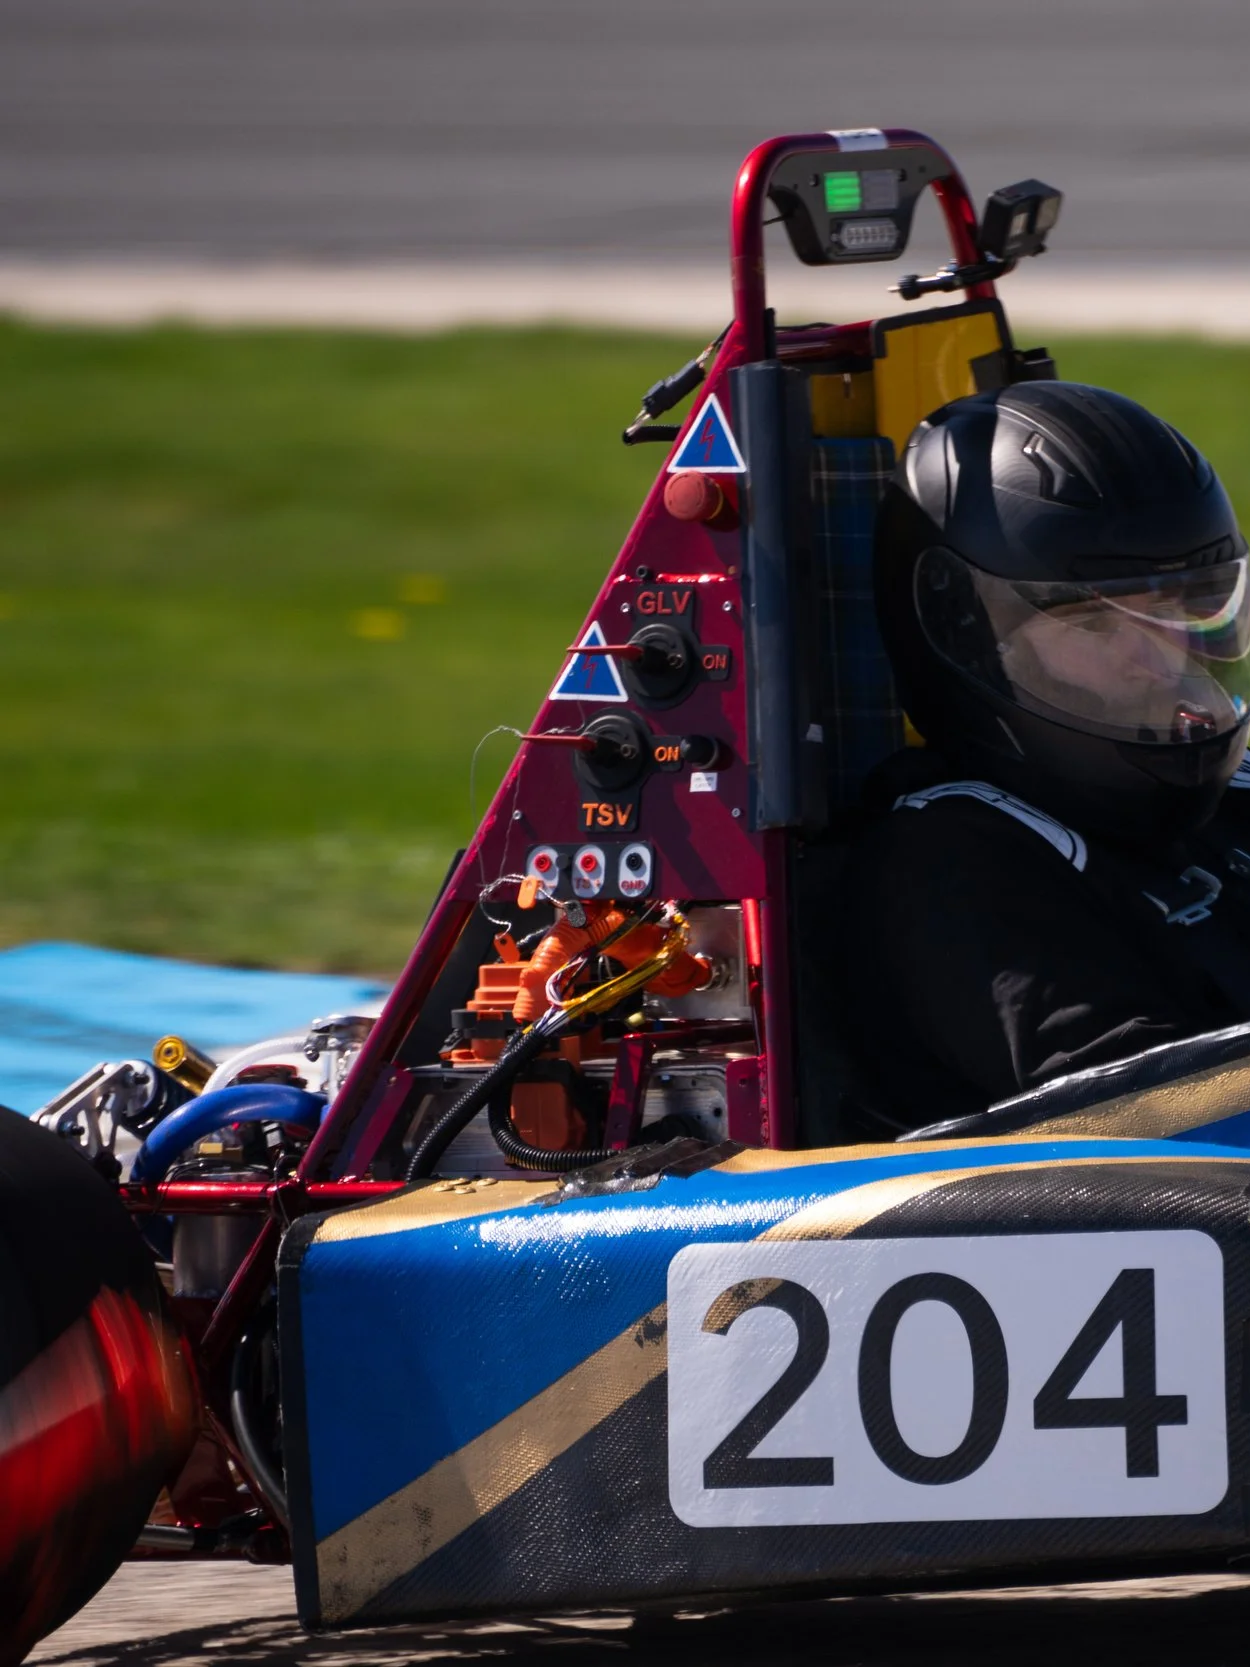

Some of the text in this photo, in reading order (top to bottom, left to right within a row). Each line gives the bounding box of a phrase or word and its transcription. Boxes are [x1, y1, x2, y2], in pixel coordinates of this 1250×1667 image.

[636, 591, 691, 615] GLV
[703, 654, 727, 670] ON
[654, 746, 680, 762] ON
[582, 803, 633, 826] TSV
[701, 1267, 1188, 1490] 204
